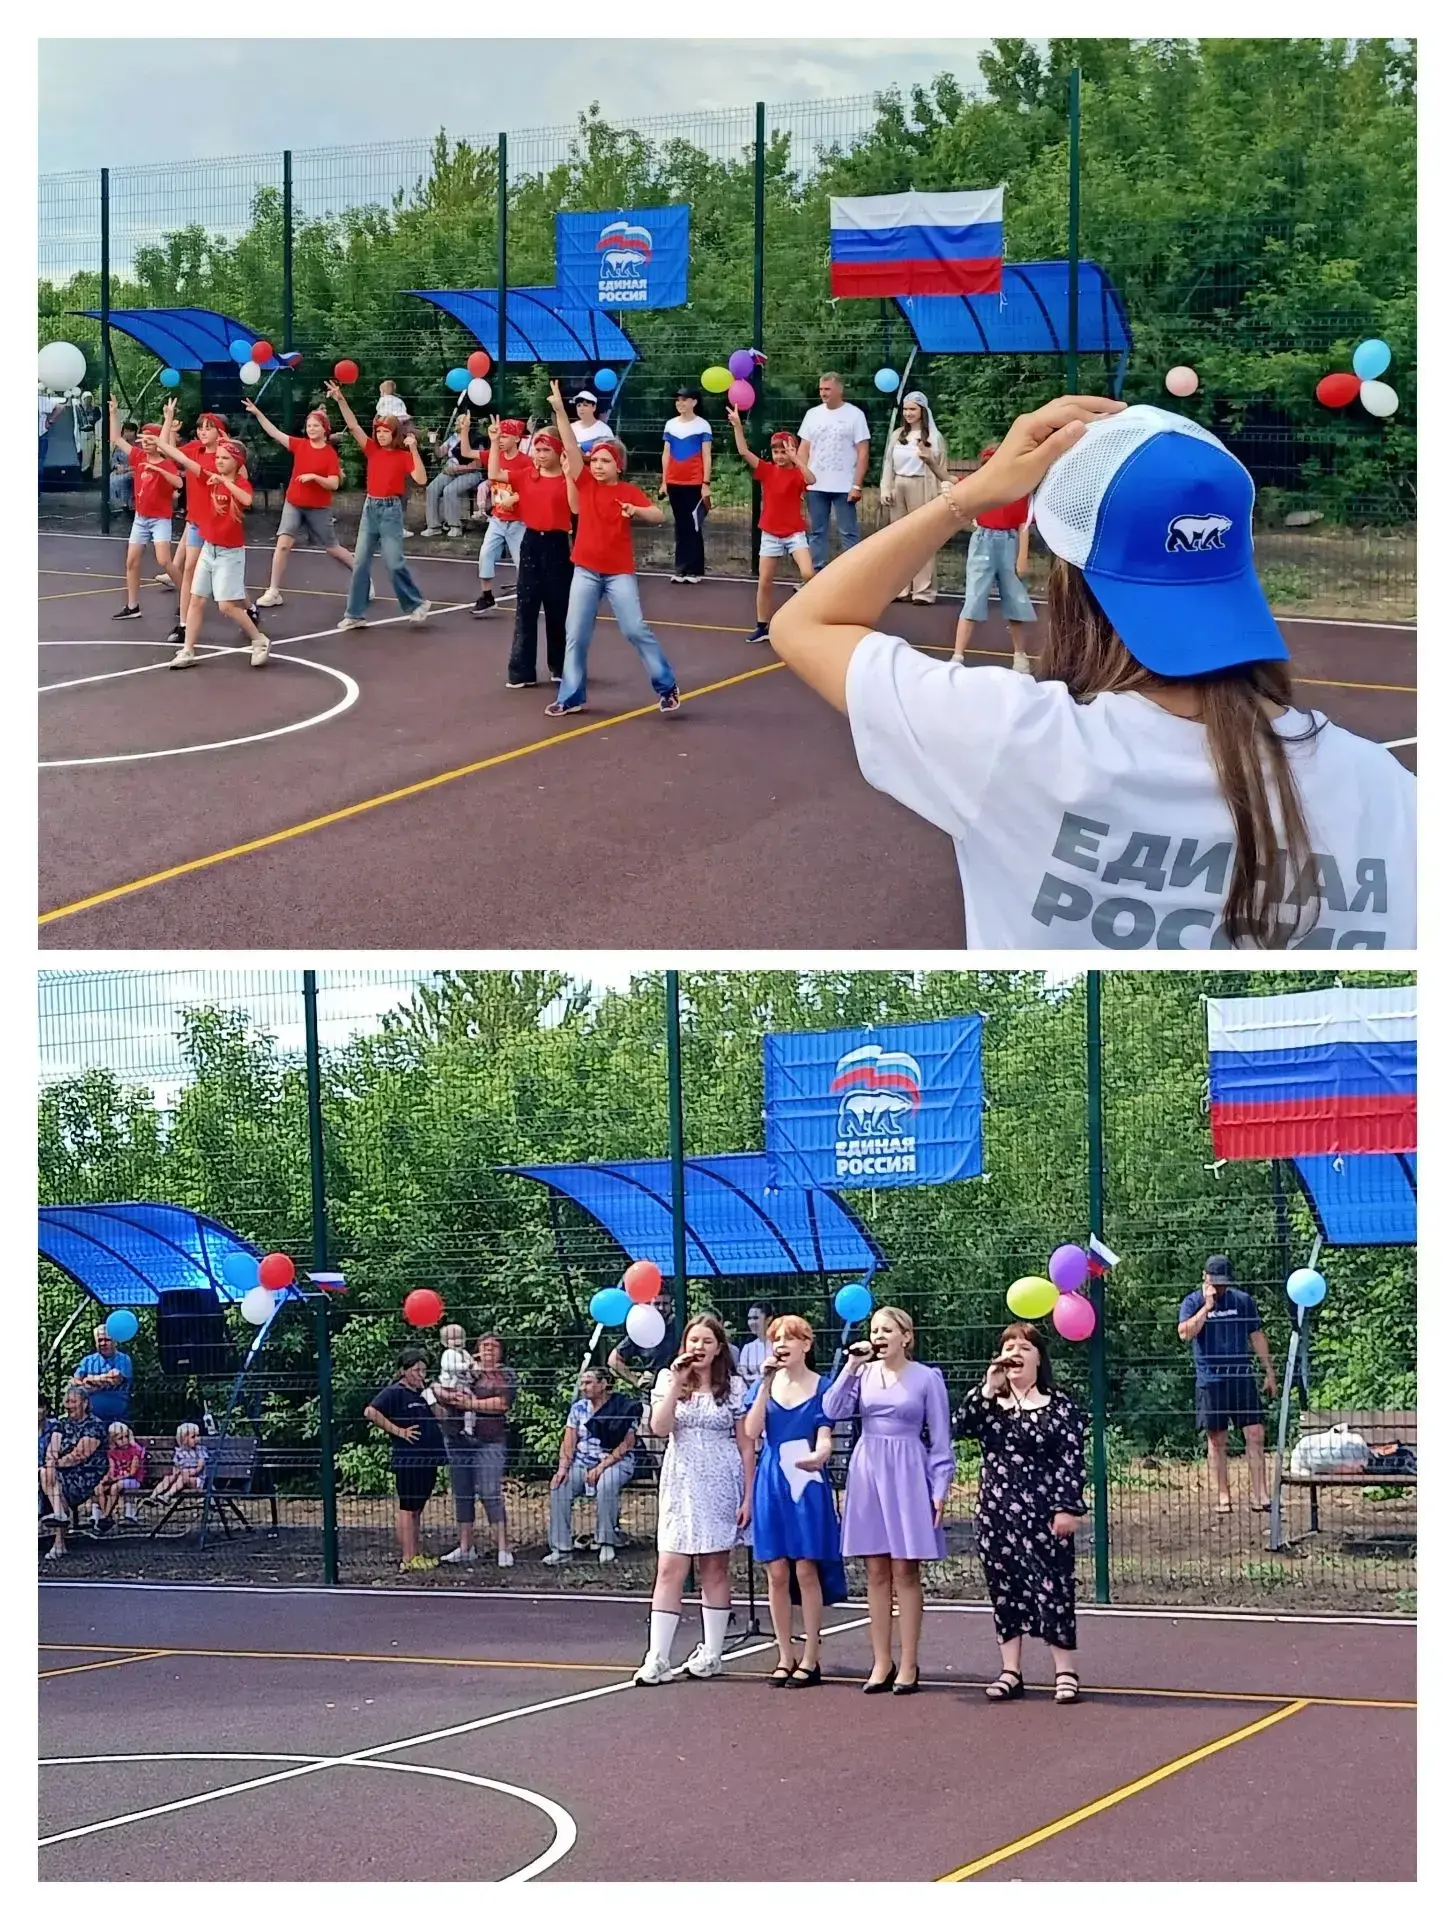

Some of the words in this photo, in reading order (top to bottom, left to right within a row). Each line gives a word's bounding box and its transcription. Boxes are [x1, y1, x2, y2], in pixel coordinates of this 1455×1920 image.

[598, 280, 647, 291] ЕДИНАЯ
[598, 291, 647, 302] РОССИЯ
[836, 1137, 915, 1157] ЕДИНАЯ
[837, 1157, 915, 1176] РОССИЯ
